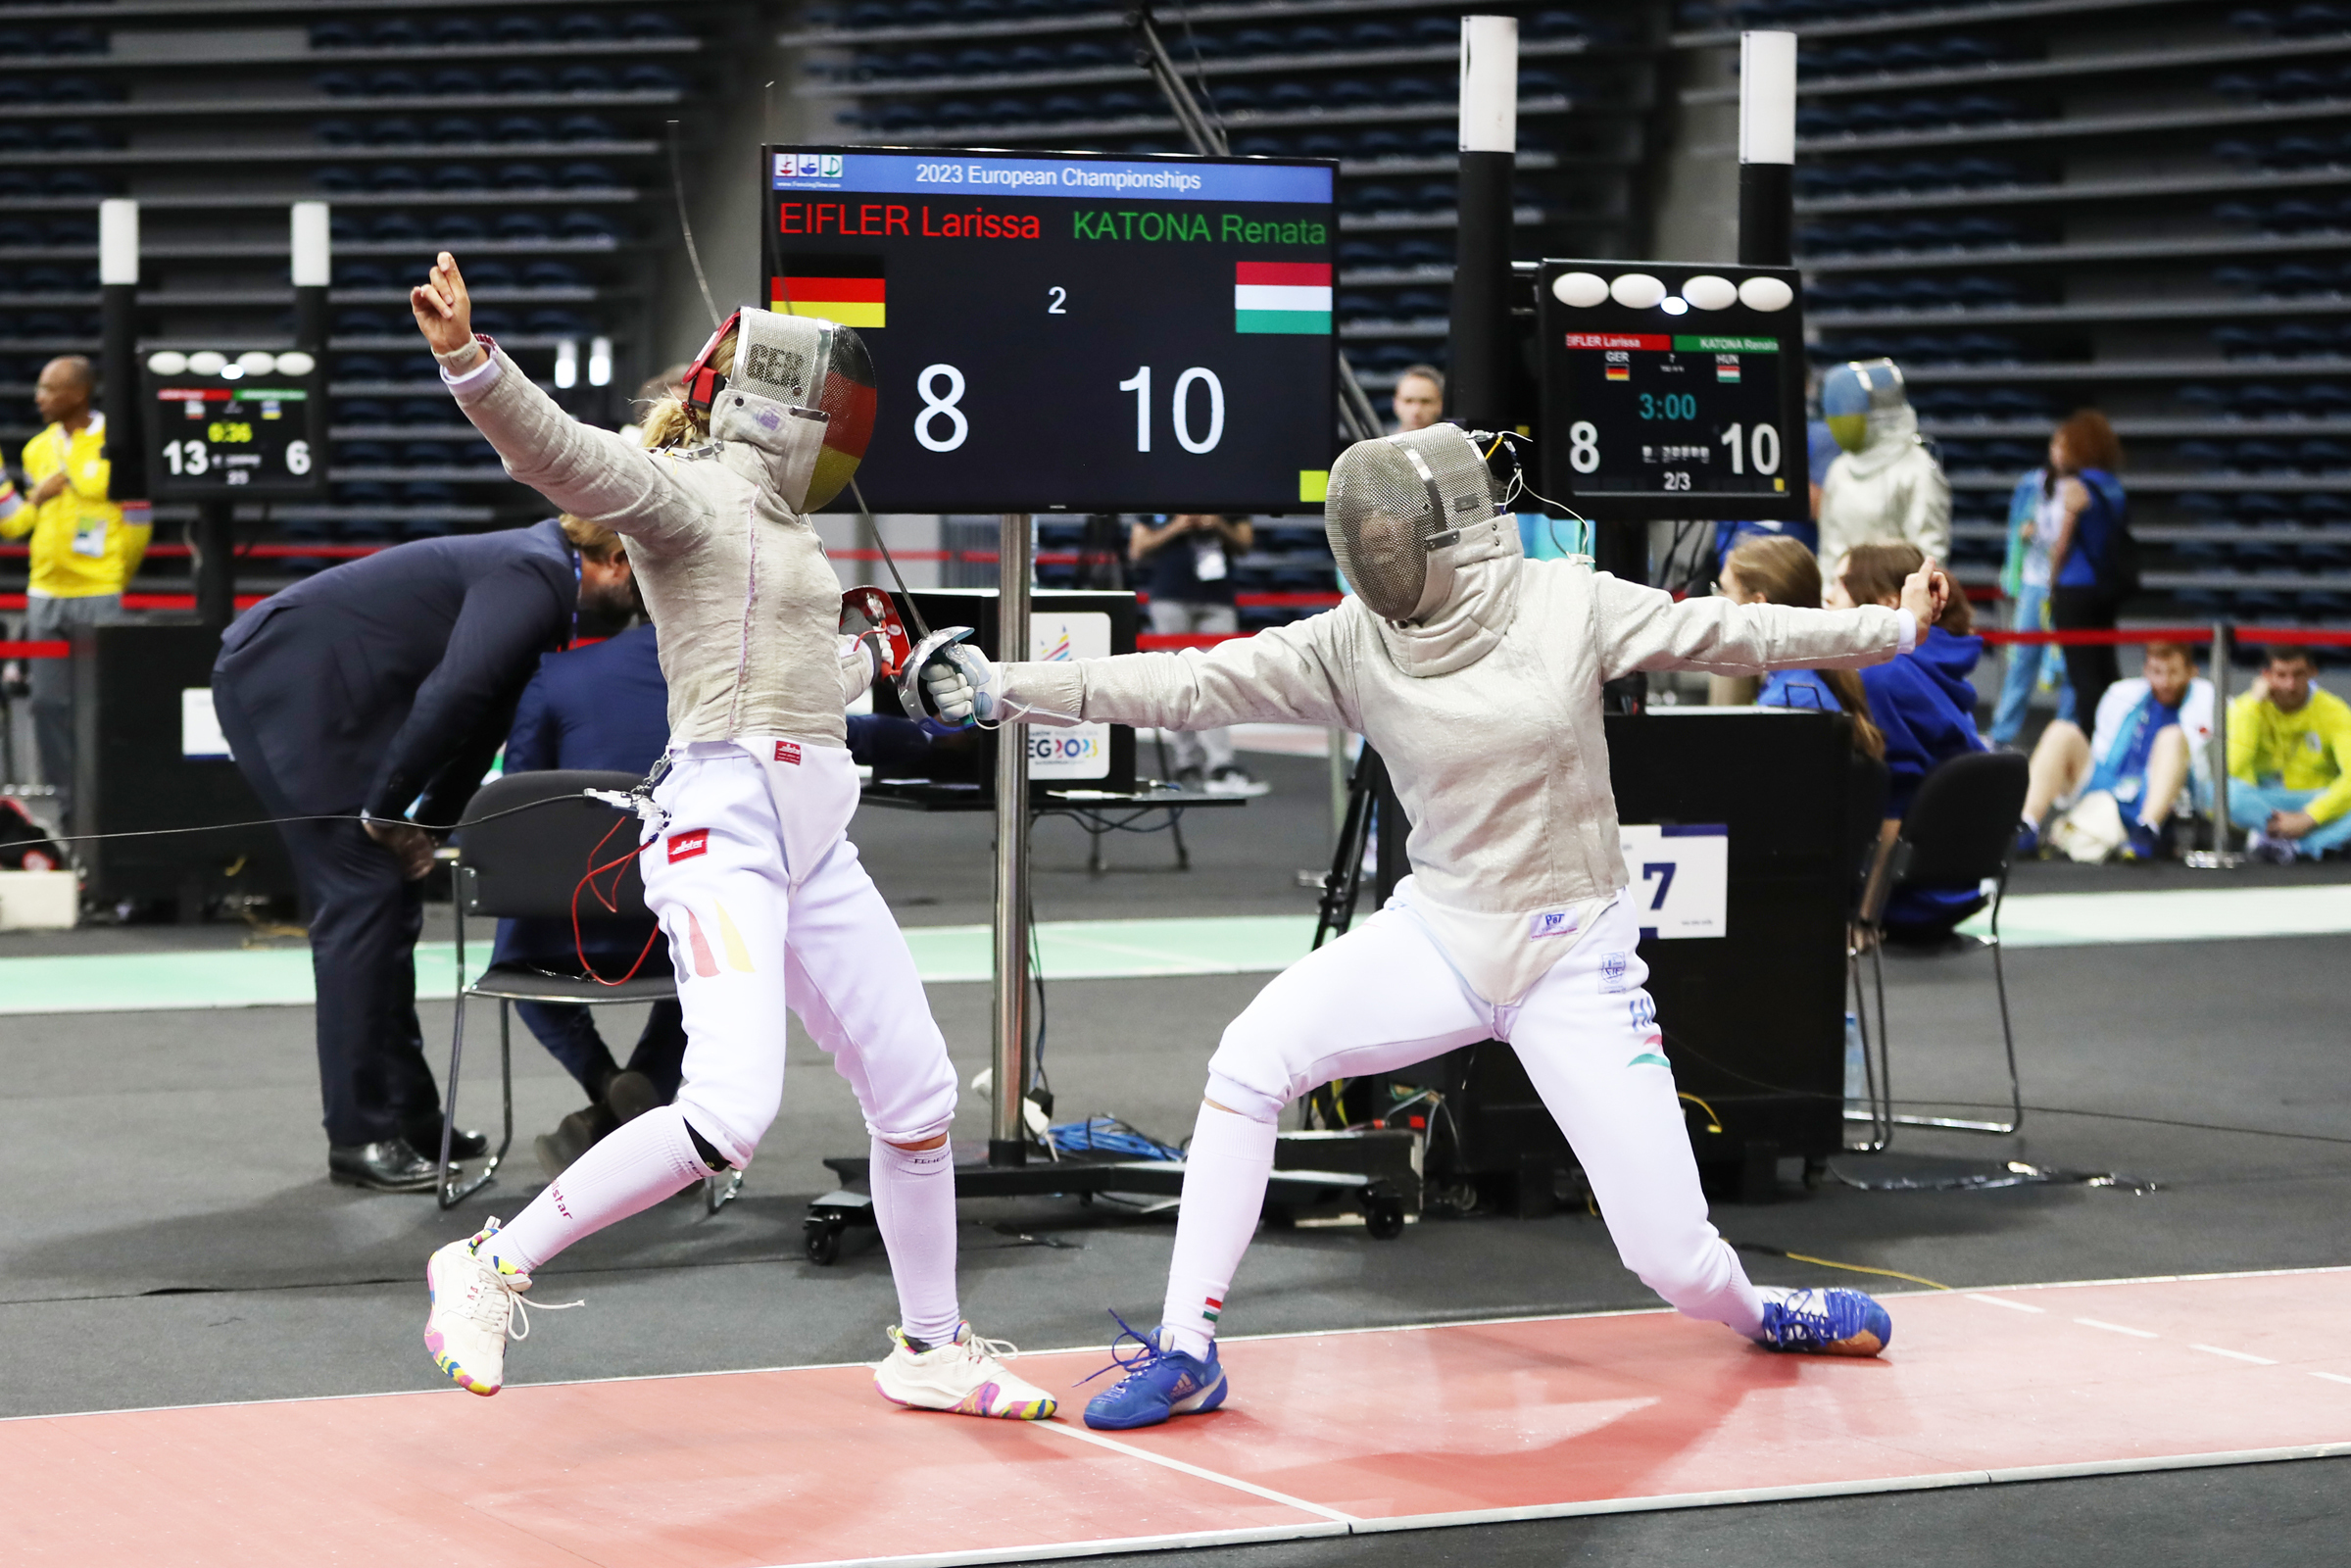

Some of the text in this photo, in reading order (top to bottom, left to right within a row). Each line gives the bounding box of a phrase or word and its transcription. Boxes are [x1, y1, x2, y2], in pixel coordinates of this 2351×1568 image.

[915, 164, 1201, 192] 2023 European Championships
[780, 202, 1040, 239] EIFLER Larissa
[1073, 211, 1327, 245] KATONA Renata
[1048, 285, 1067, 315] 2
[1605, 350, 1630, 363] GER
[1699, 337, 1744, 350] KATONA
[1715, 354, 1739, 365] HUN
[914, 364, 969, 453] 8
[1119, 366, 1225, 455] 10
[1639, 393, 1696, 419] 3:00
[163, 440, 209, 475] 13
[285, 440, 312, 475] 6
[1570, 420, 1600, 473] 8
[1721, 422, 1781, 475] 10
[1663, 471, 1691, 491] 2/3
[1642, 861, 1676, 910] 7
